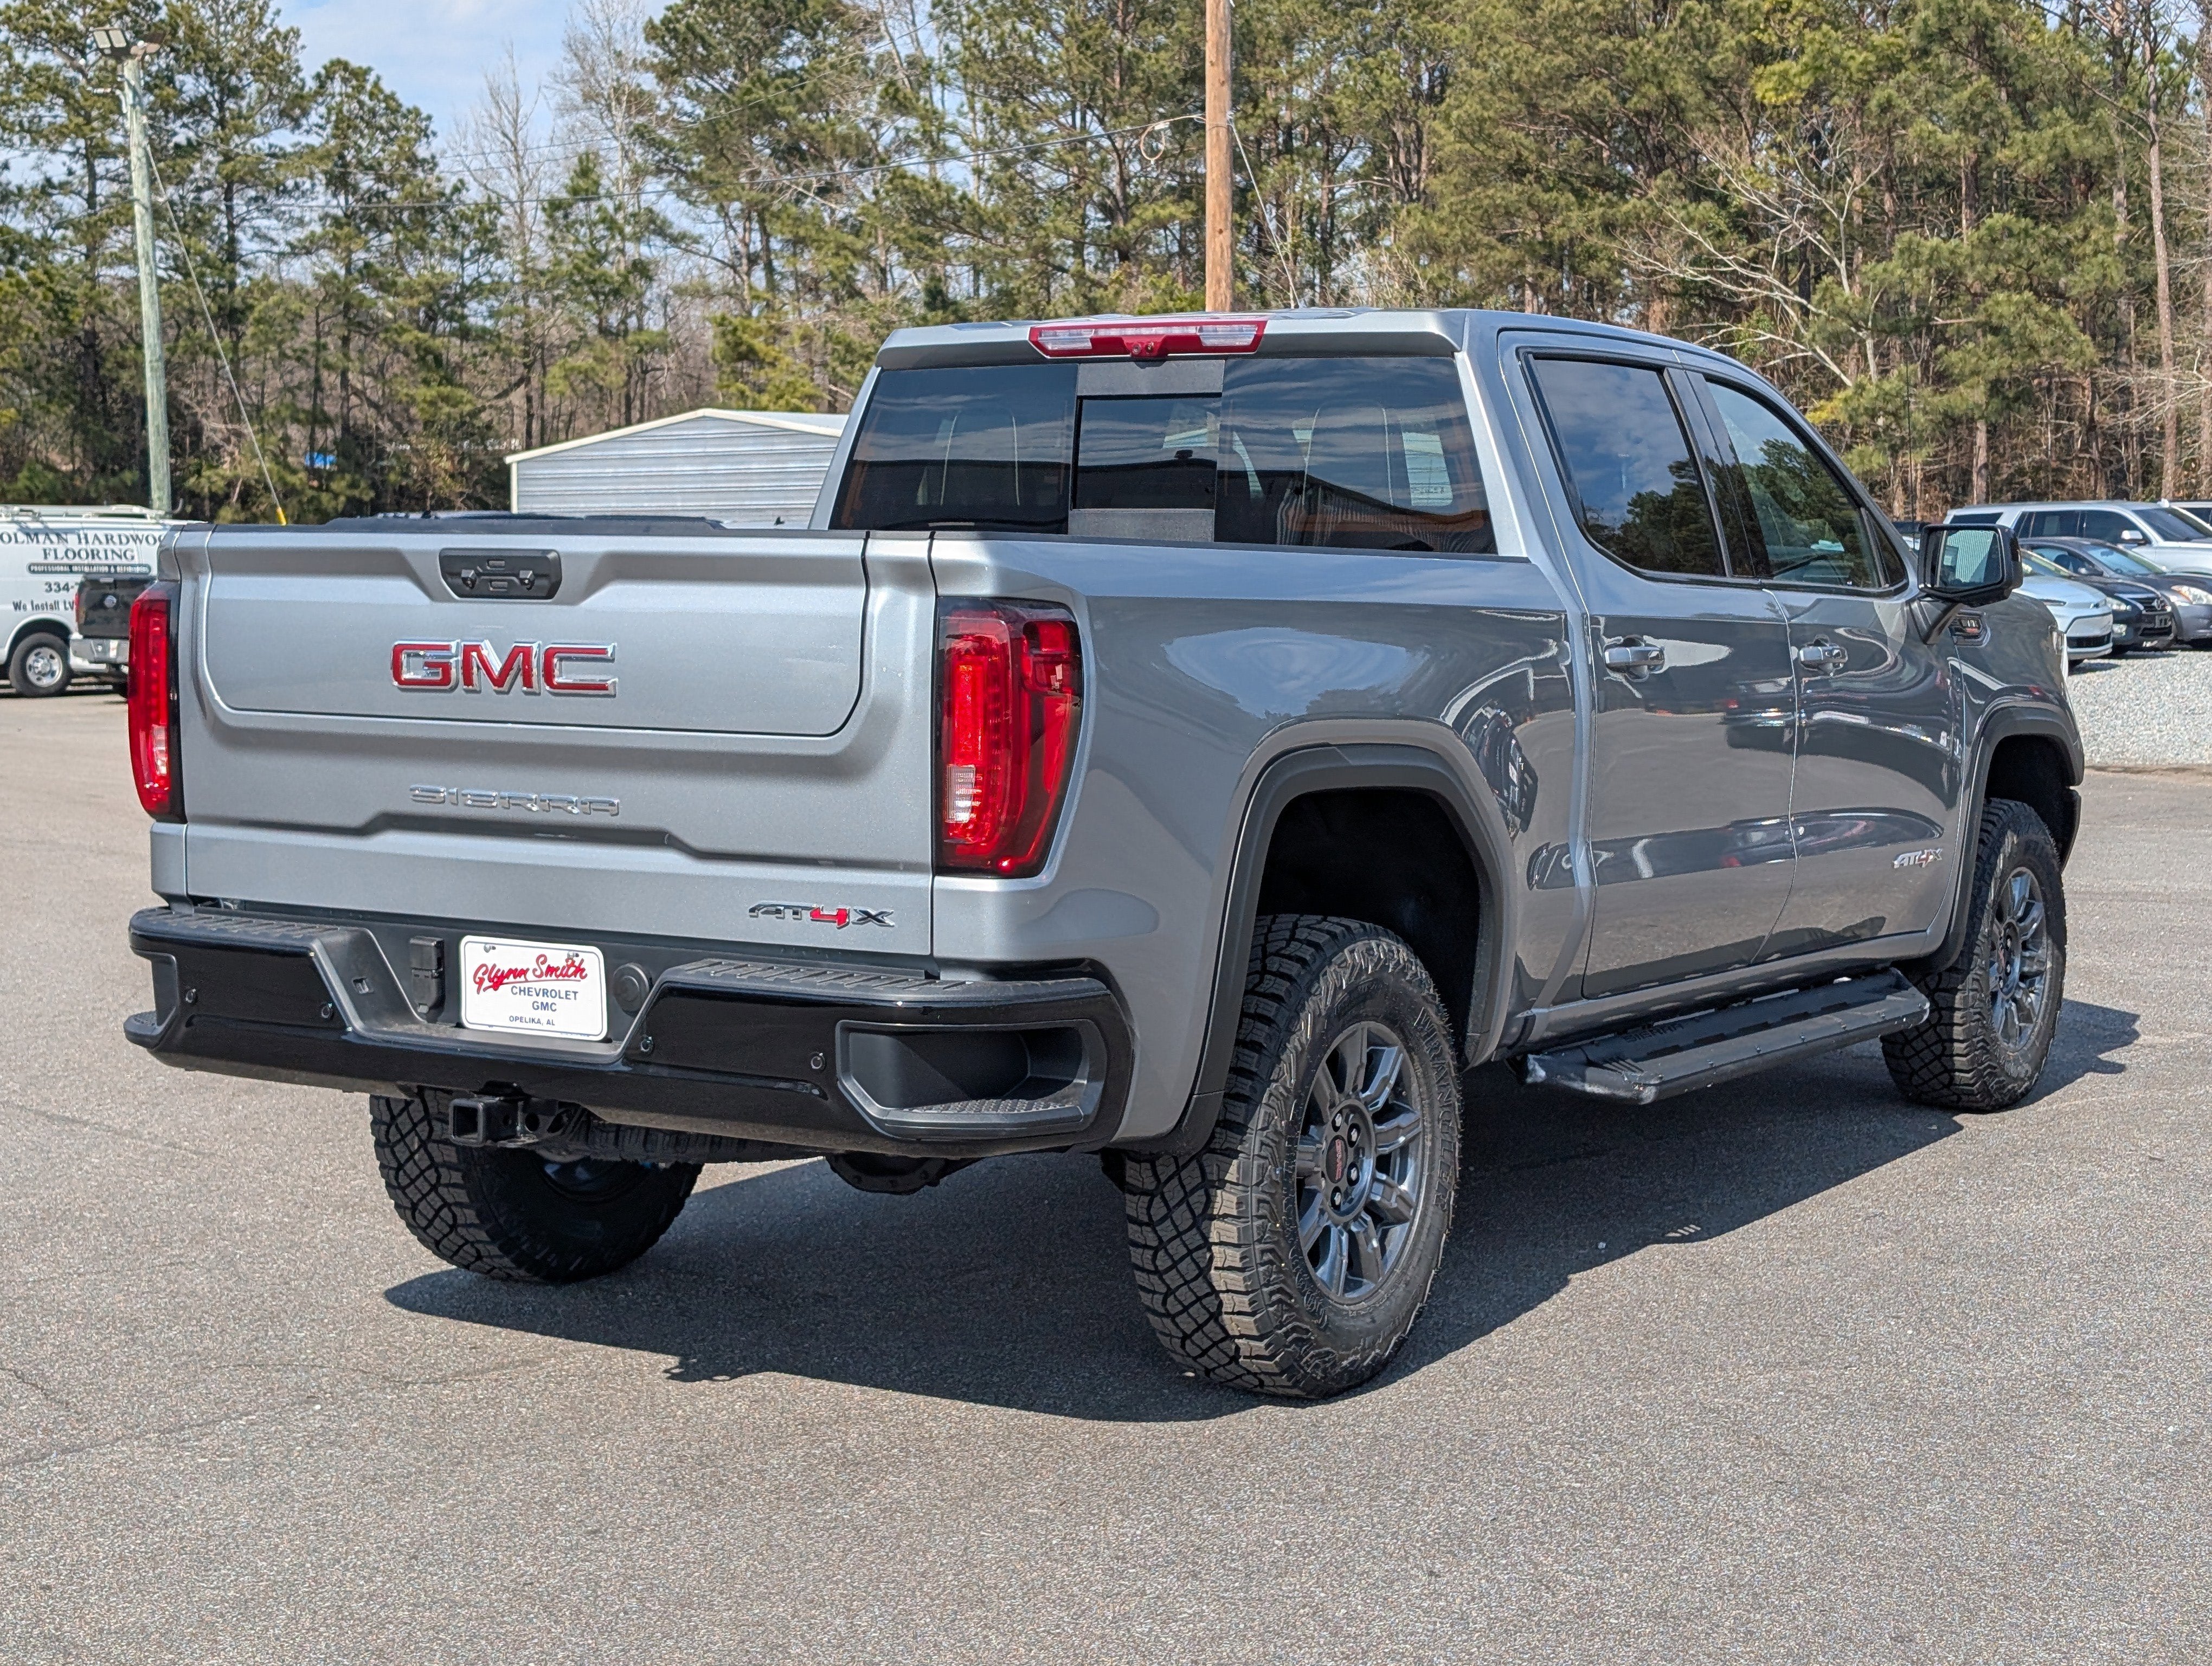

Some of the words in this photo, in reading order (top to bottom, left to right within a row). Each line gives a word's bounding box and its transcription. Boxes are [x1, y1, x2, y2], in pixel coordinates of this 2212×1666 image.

[43, 547, 136, 561] FLOORING
[12, 599, 27, 611] We
[30, 599, 60, 611] Install
[390, 639, 618, 696] GMC
[409, 784, 620, 816] SIERRA
[1891, 848, 1943, 868] AT4X
[748, 900, 895, 929] AT4X
[473, 963, 530, 995] Glynn
[532, 953, 588, 980] Smith
[511, 985, 579, 1001] CHEVROLET
[532, 1001, 557, 1013] GMC
[509, 1015, 544, 1026] OPELIKA,
